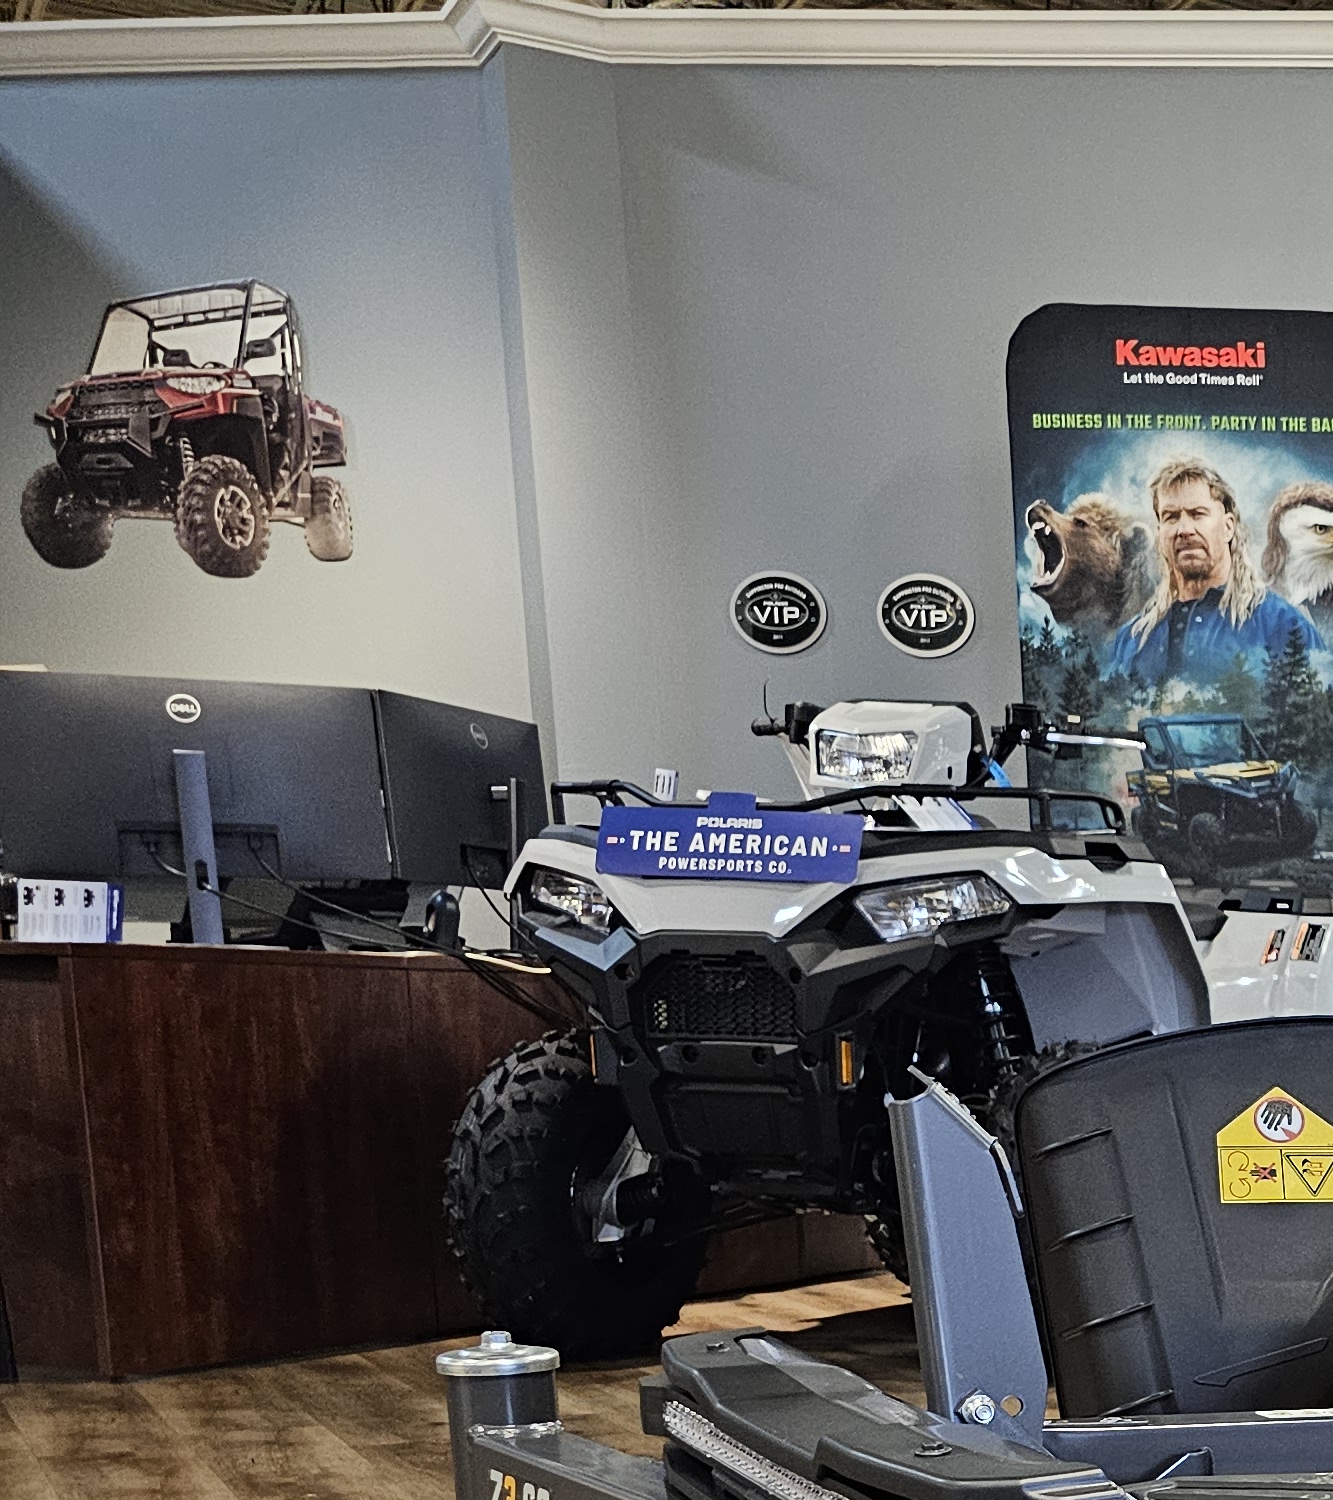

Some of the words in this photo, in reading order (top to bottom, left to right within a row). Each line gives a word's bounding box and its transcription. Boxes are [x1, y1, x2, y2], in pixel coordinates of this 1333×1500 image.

[1115, 339, 1265, 368] Kawasaki
[1123, 372, 1142, 384] Let
[1144, 372, 1164, 384] the
[1166, 372, 1198, 385] Good
[1200, 373, 1234, 386] Times
[1032, 413, 1103, 429] BUSINESS
[1107, 413, 1122, 429] IN
[1125, 414, 1152, 430] THE
[1157, 414, 1206, 430] FRONT.
[1210, 415, 1257, 430] PARTY
[1261, 416, 1276, 431] IN
[1280, 416, 1307, 432] THE
[753, 605, 800, 625] VIP
[900, 608, 948, 628] VIP
[696, 816, 763, 829] POLARIS
[629, 830, 680, 850] THE
[689, 833, 828, 857] AMERICAN
[658, 856, 763, 873] POWERSPORTS
